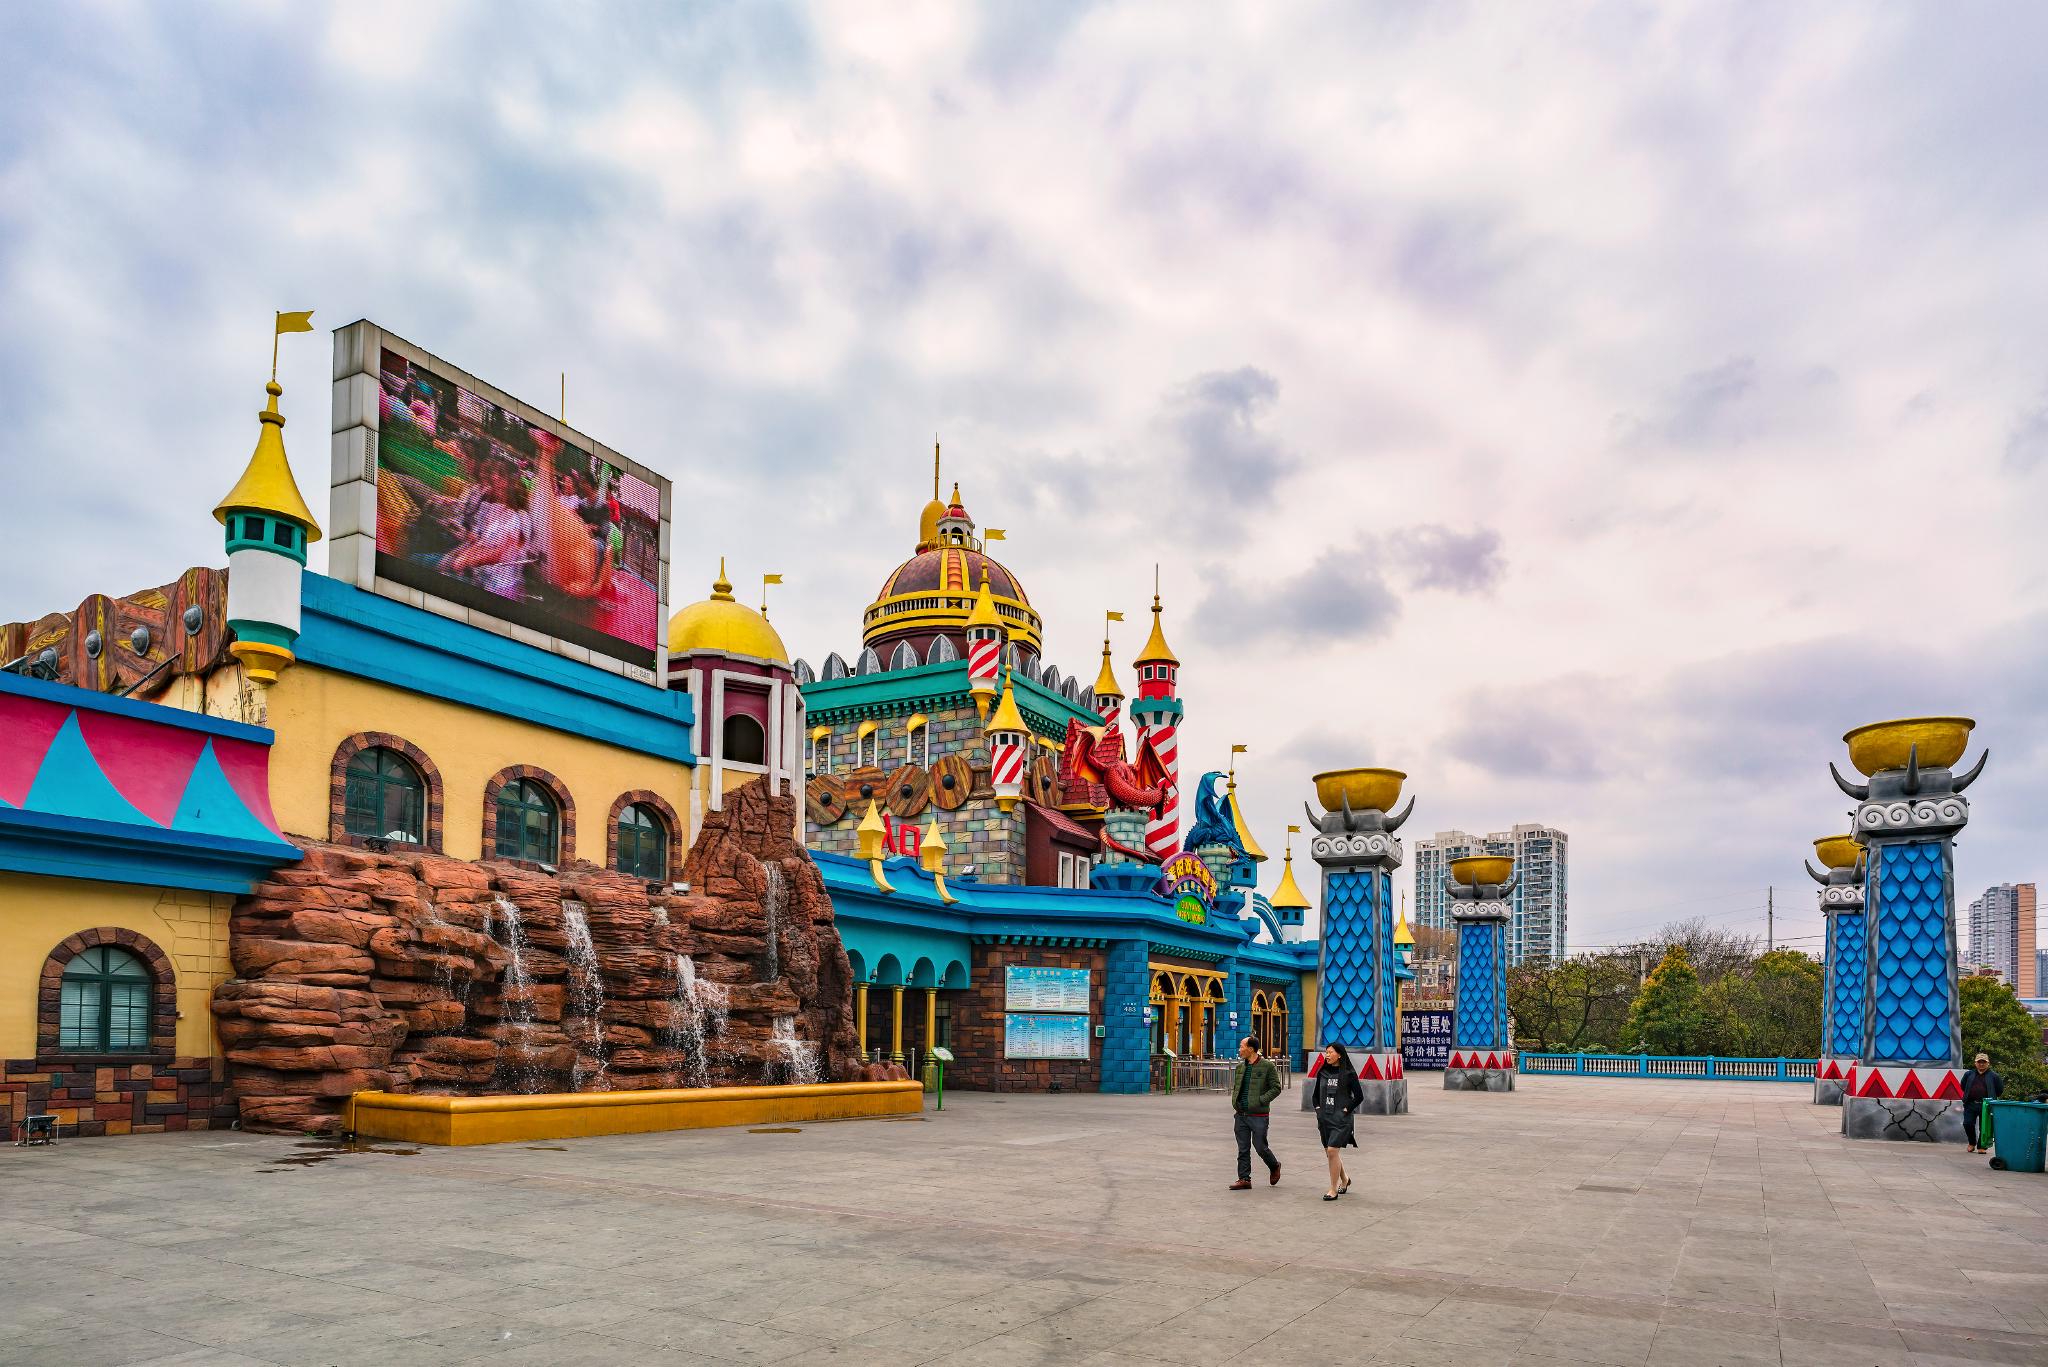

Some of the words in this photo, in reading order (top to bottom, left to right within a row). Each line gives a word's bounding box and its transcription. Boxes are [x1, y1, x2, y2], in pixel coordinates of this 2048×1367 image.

[1401, 1015, 1451, 1034] 航空售票处
[1404, 1046, 1447, 1057] 特价机票
